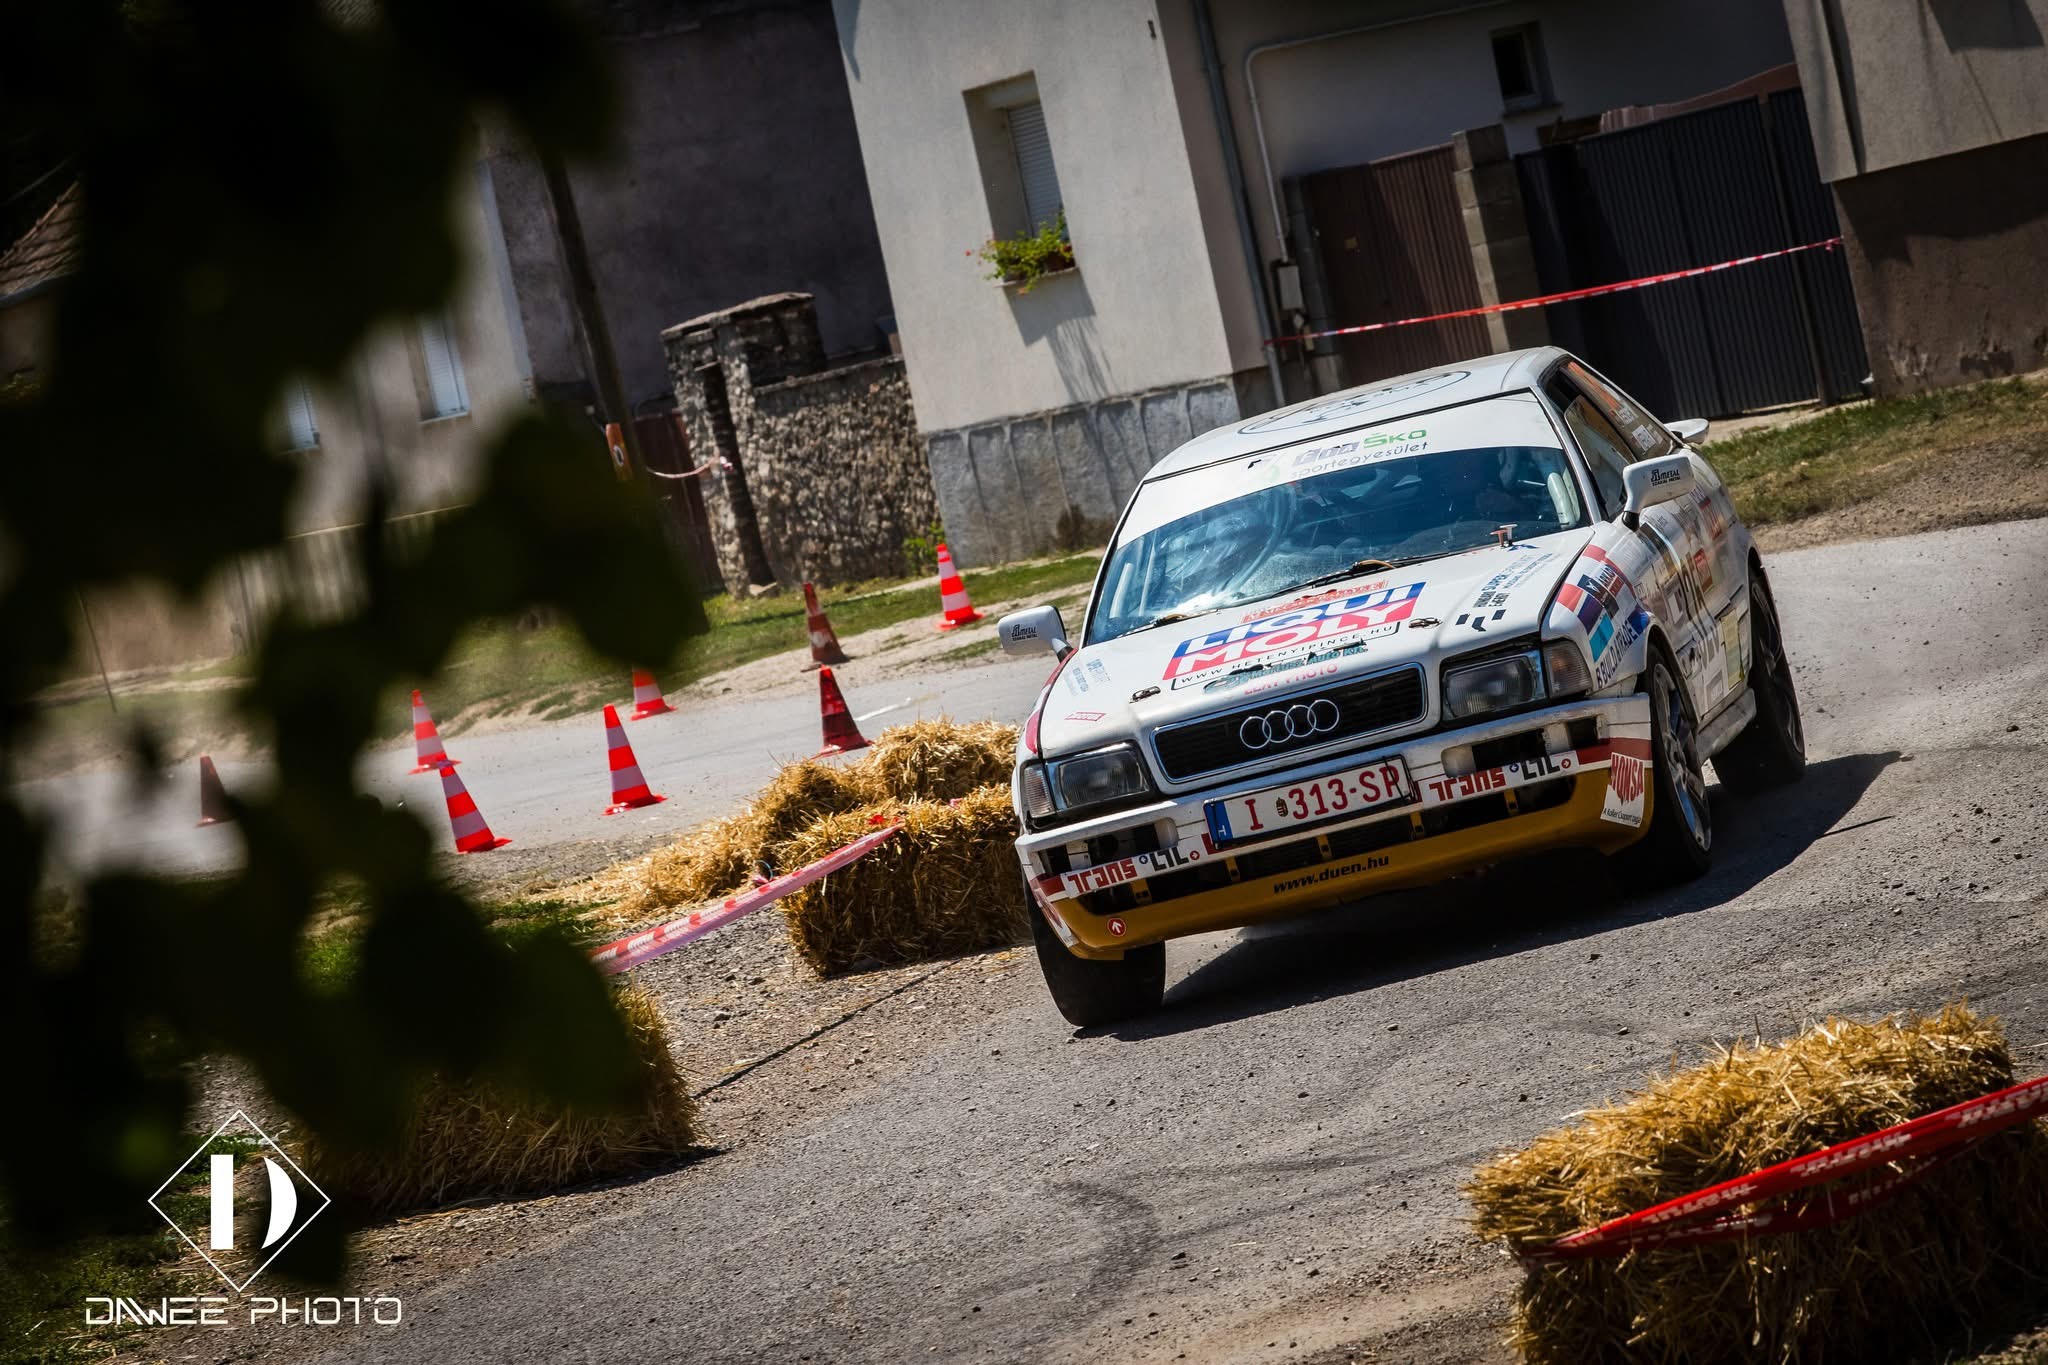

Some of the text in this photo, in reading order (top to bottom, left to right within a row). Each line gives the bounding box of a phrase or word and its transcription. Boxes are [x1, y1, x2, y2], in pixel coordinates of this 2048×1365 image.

[1174, 600, 1411, 677] MOLY
[1183, 584, 1413, 656] LIQUI
[1244, 764, 1400, 831] I 313-SP
[1273, 855, 1389, 894] www.duen.hu
